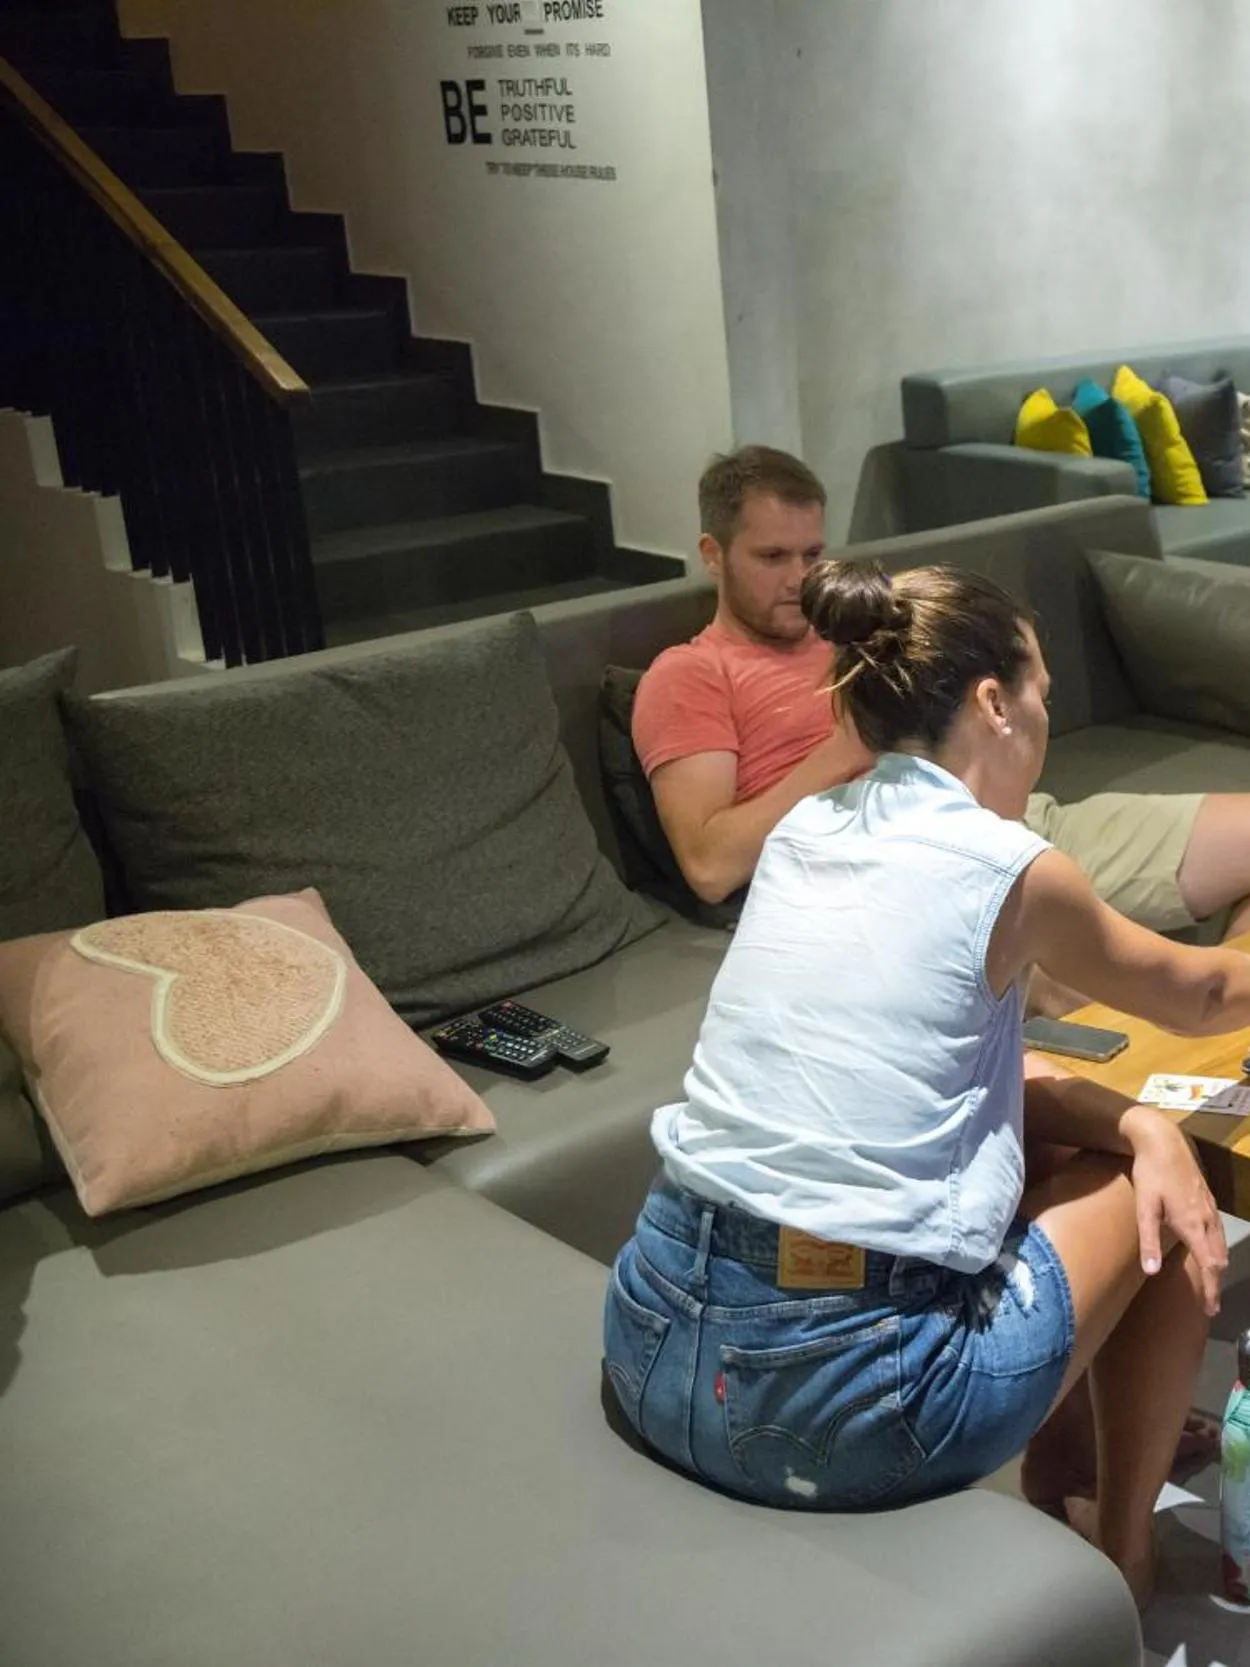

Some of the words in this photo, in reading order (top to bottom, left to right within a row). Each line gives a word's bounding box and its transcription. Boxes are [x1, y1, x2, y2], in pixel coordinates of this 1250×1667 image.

[447, 6, 479, 26] KEEP
[486, 3, 521, 24] YOUR
[544, 0, 604, 22] PROMISE
[534, 43, 560, 57] WHEN
[585, 43, 611, 57] HARD
[498, 78, 573, 97] TRUTHFUL
[440, 80, 492, 145] BE
[501, 104, 576, 123] POSITIVE
[502, 128, 577, 149] GRATEFUL
